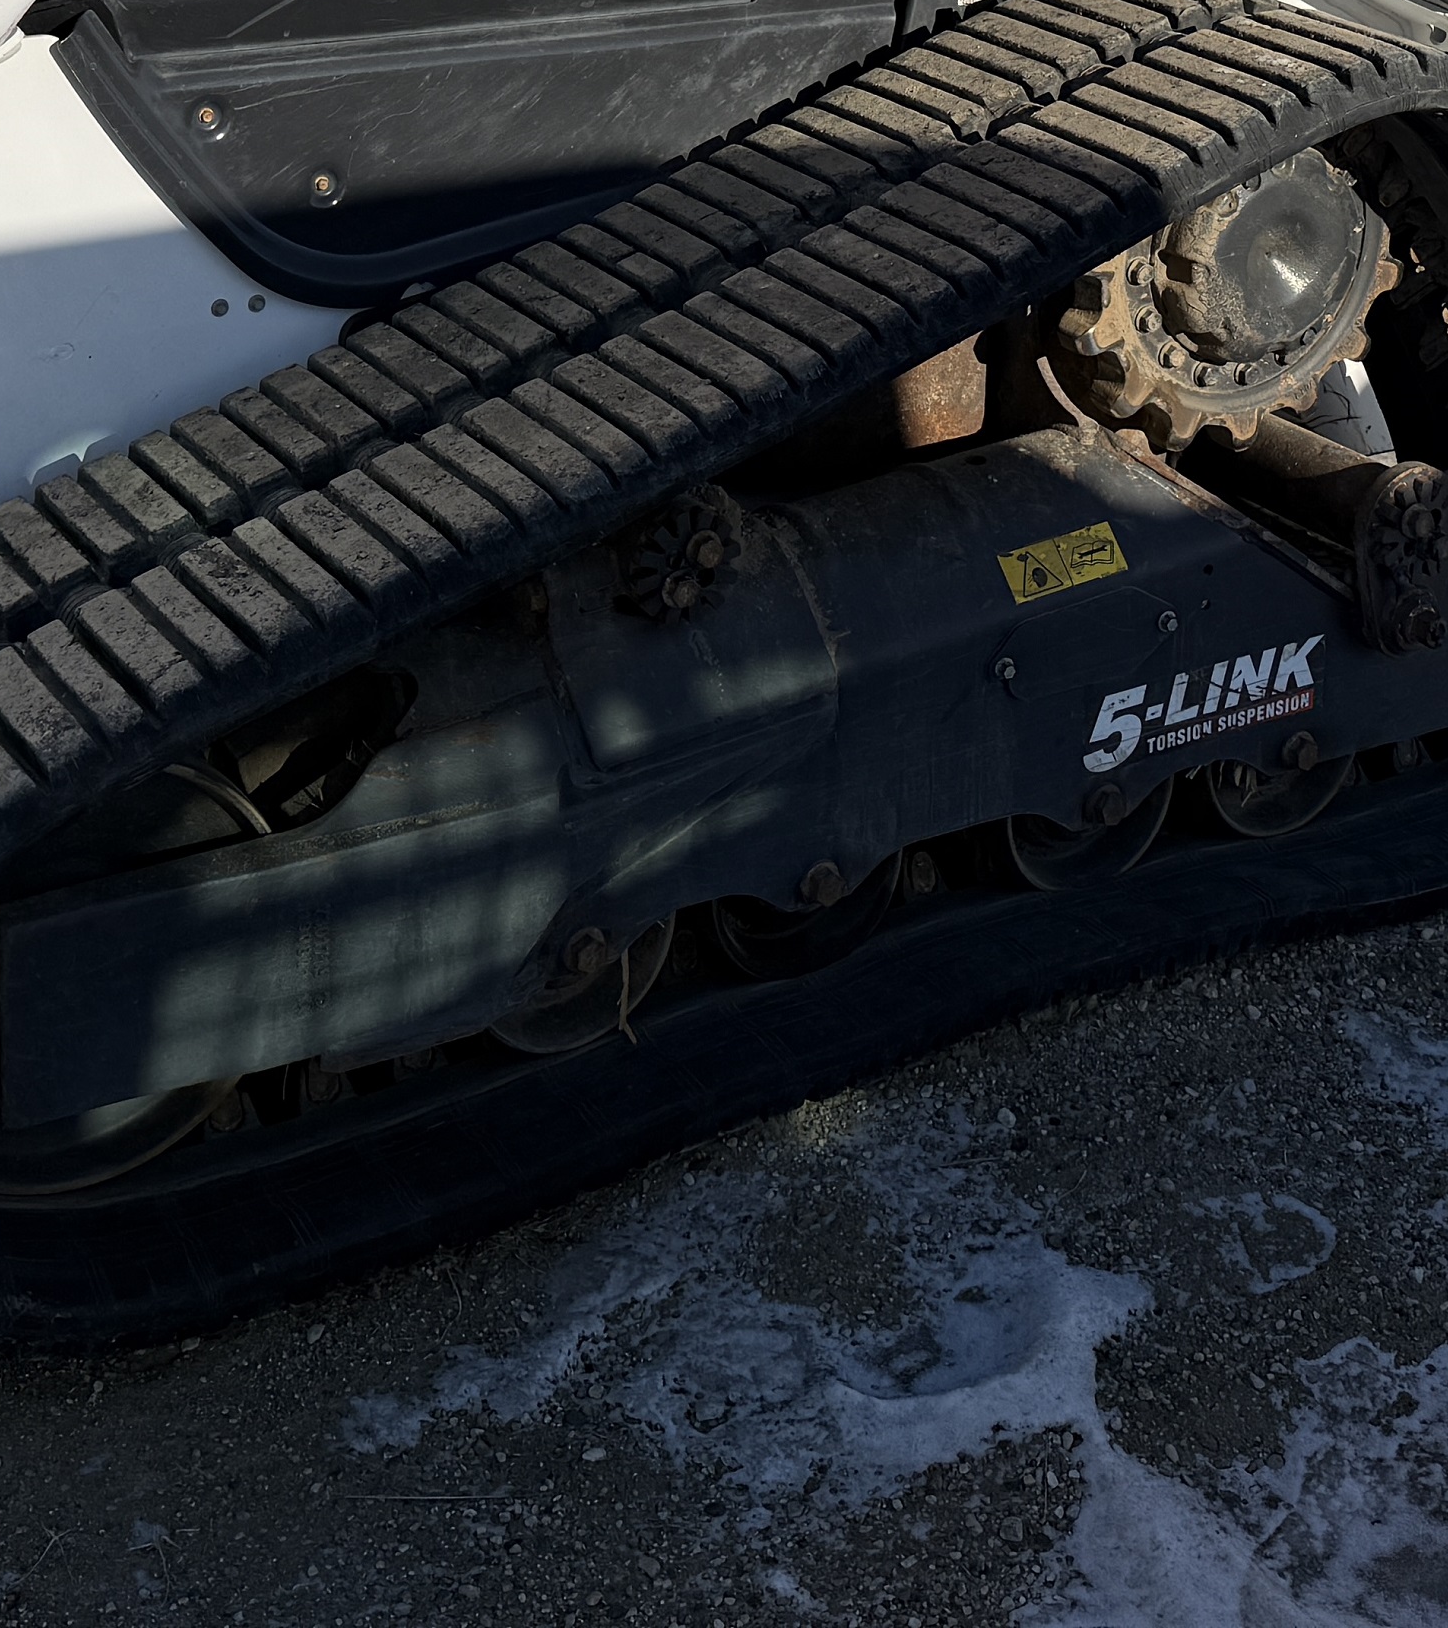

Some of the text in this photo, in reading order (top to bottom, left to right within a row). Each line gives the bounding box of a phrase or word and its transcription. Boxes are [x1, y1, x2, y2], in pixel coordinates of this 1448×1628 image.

[1082, 633, 1326, 774] 5-LINK
[1147, 691, 1311, 755] TORSION SUSPENSION
